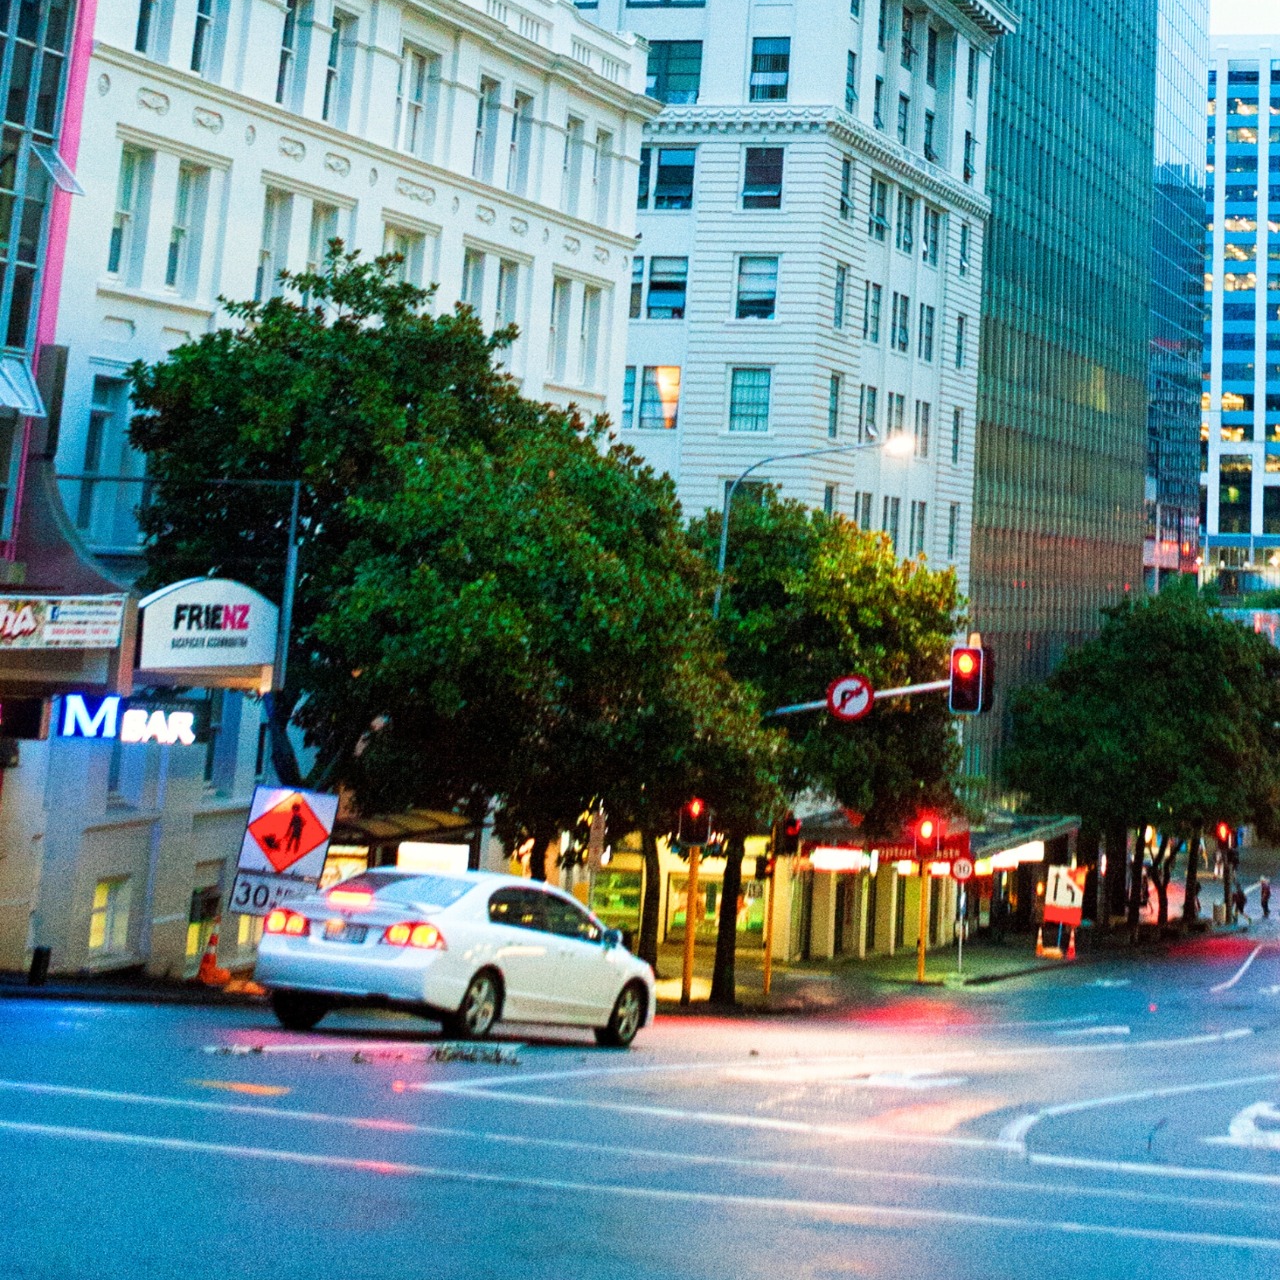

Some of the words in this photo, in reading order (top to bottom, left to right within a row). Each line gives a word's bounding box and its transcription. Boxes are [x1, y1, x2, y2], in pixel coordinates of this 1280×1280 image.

[172, 603, 251, 631] FRIENZ
[63, 694, 120, 738] M
[120, 709, 196, 746] BAR
[234, 881, 271, 908] 30
